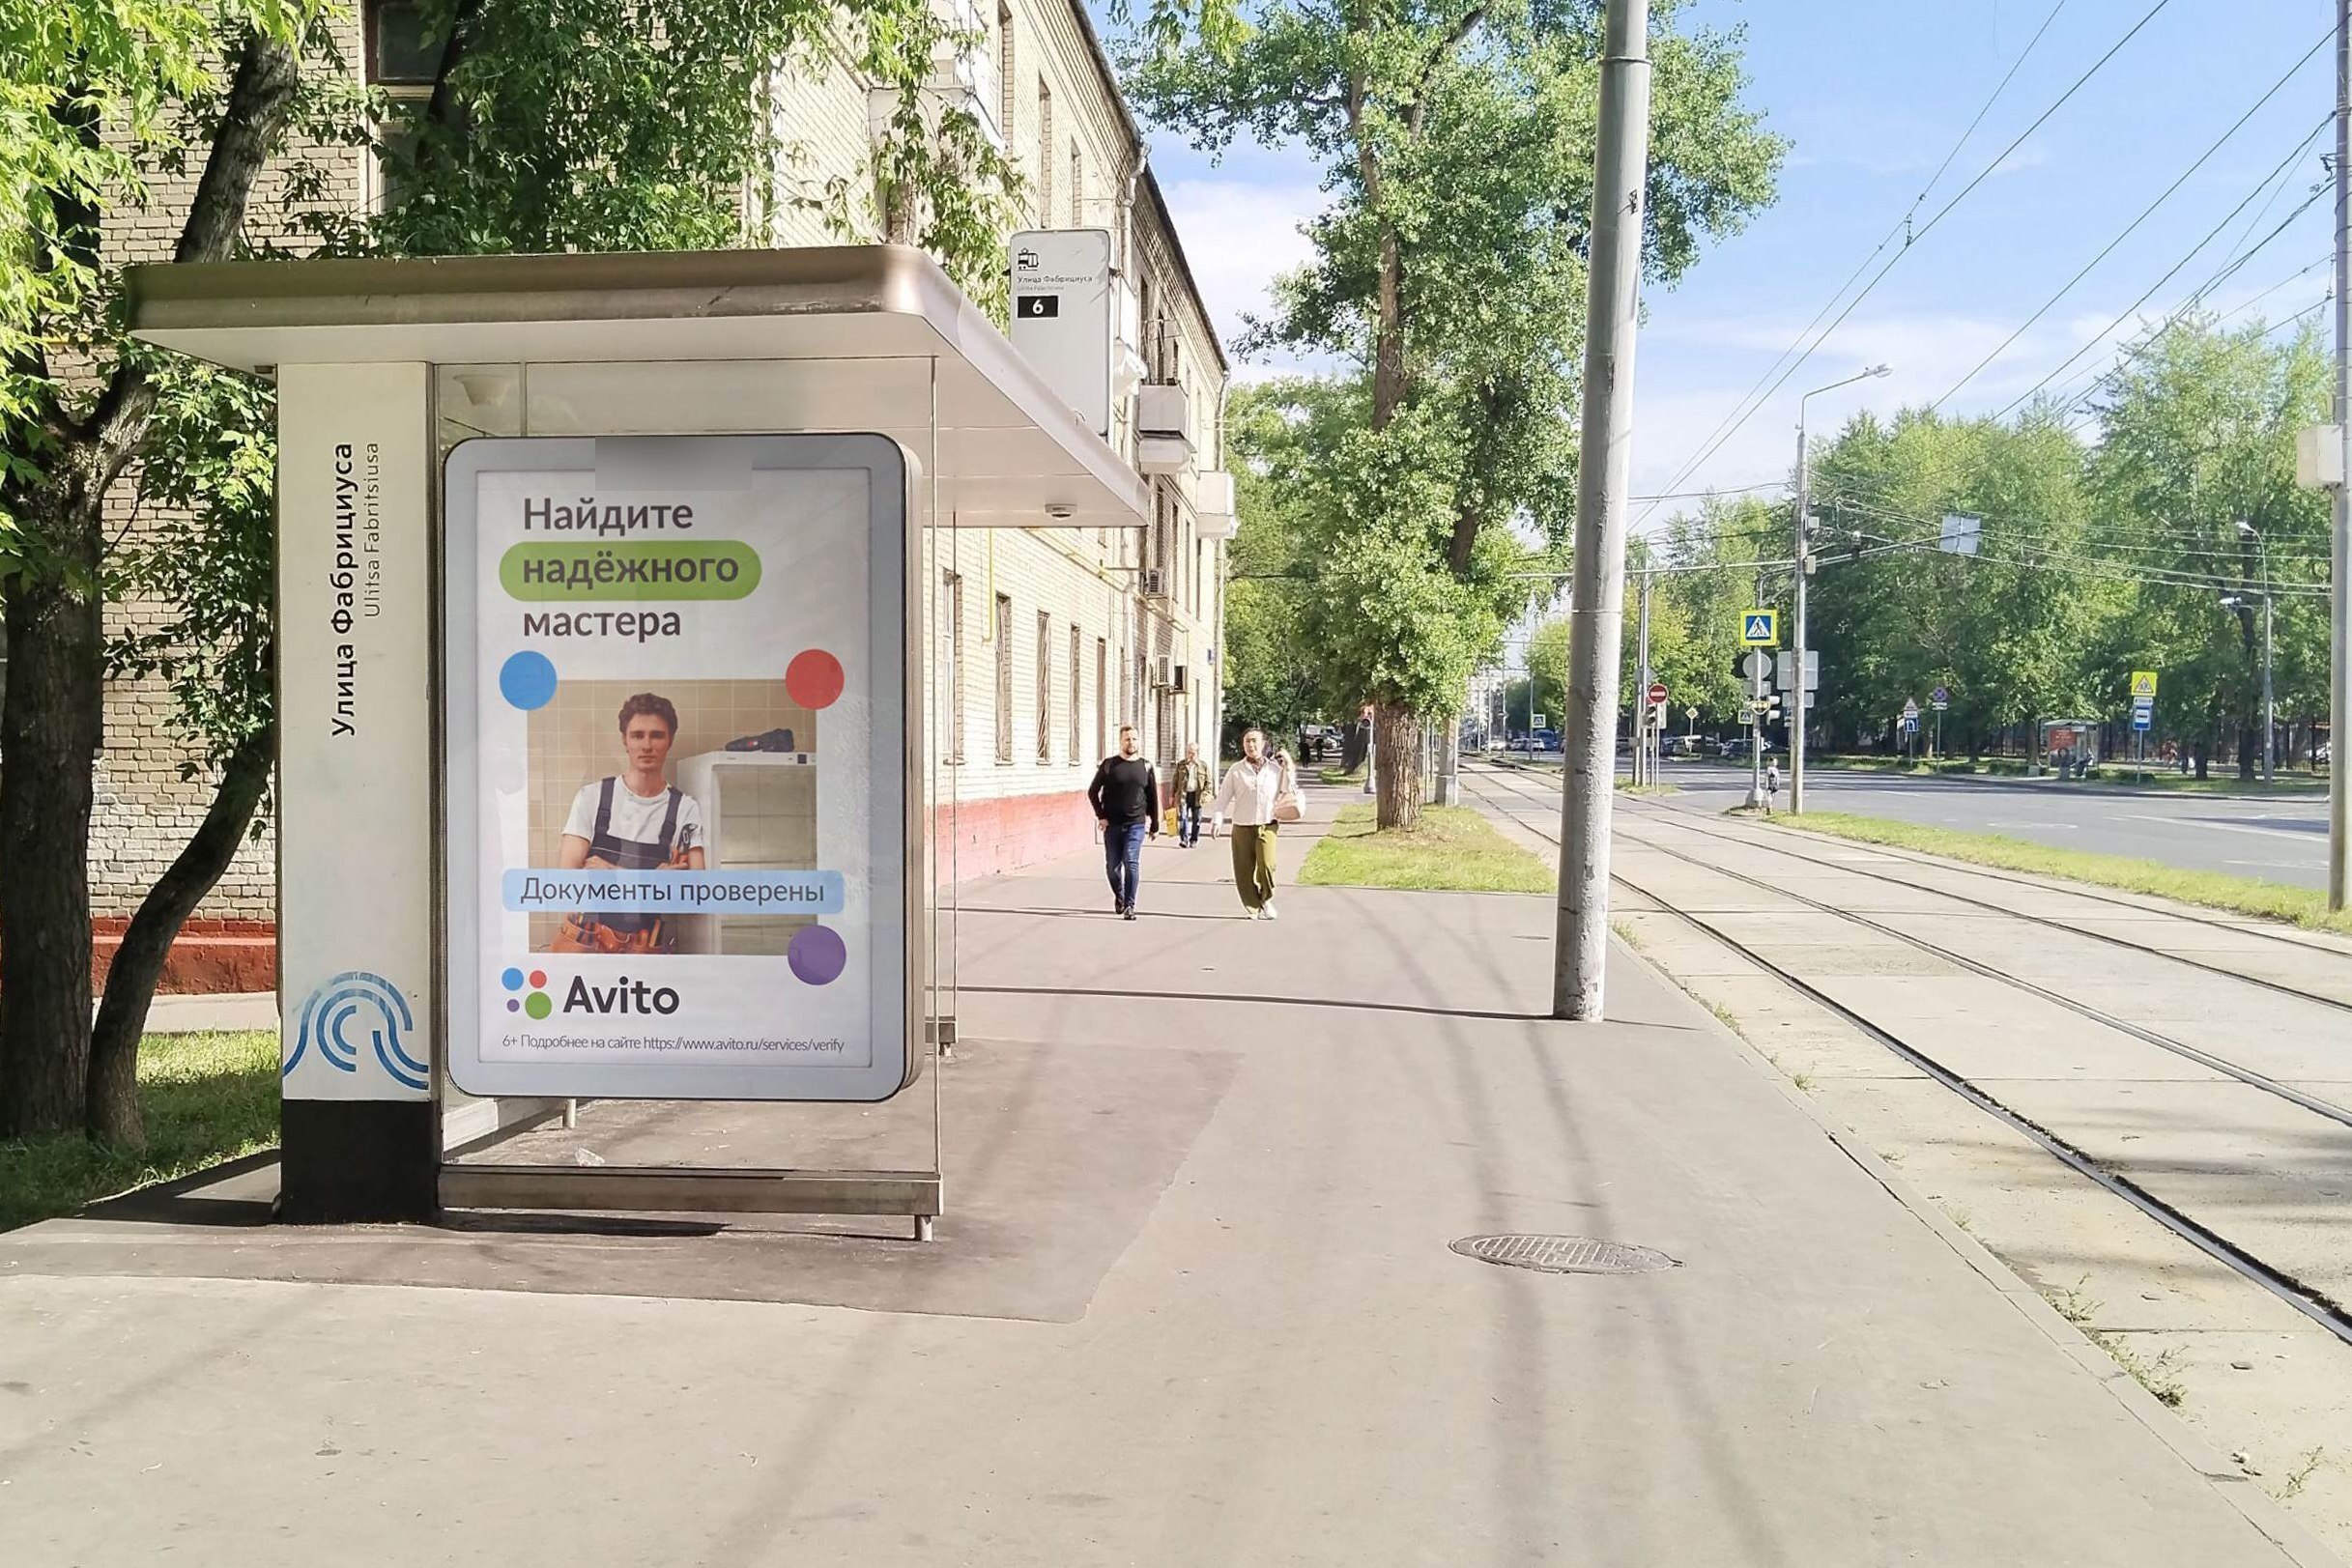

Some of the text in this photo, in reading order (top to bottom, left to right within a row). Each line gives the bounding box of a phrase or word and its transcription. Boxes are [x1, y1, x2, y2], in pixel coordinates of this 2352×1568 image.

[1032, 299, 1044, 315] 6
[362, 442, 381, 617] Ulitsa Fabritsiusa
[524, 497, 694, 536] Найдите
[330, 442, 359, 736] Улица Фабрициуса
[523, 551, 739, 590] надёжного
[524, 612, 681, 643] мастера
[520, 877, 824, 906] Документы проверены
[562, 975, 680, 1015] Avito
[502, 1034, 845, 1053] 6+ Подробнее на сайте https://www.avito.ru/services/verify
